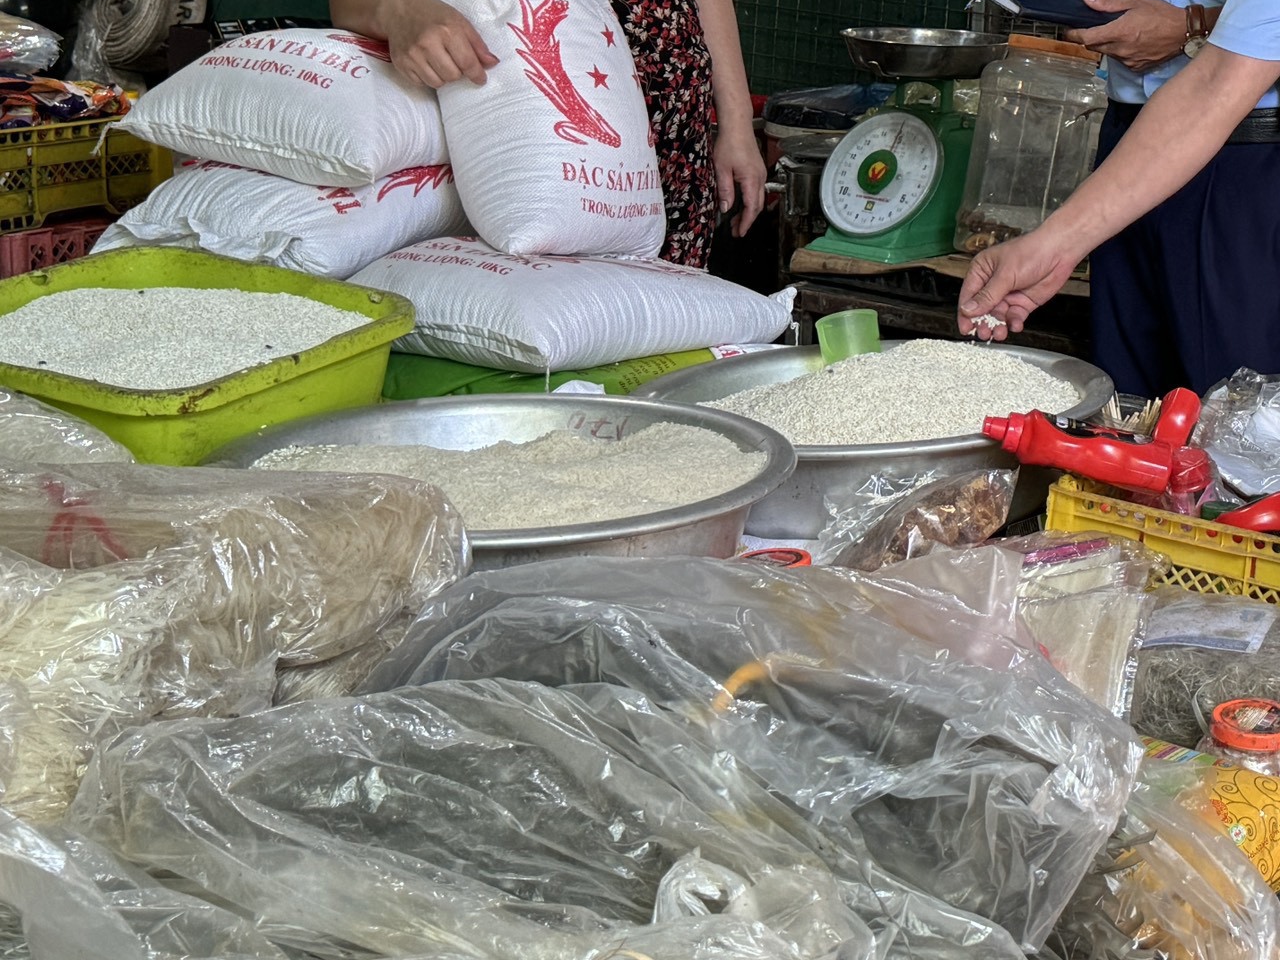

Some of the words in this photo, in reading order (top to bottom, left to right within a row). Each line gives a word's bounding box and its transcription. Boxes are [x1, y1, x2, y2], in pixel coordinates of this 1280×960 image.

[242, 57, 296, 76] LƯỢNG:
[296, 69, 334, 90] 10KG
[281, 40, 326, 60] TÂY
[321, 54, 371, 79] BẮC
[562, 158, 603, 189] ĐẶC
[606, 162, 635, 191] SẢN
[839, 186, 849, 196] 10
[580, 197, 616, 219] TRỌNG
[617, 202, 648, 222] LƯỢNG:
[476, 261, 514, 276] 10KG
